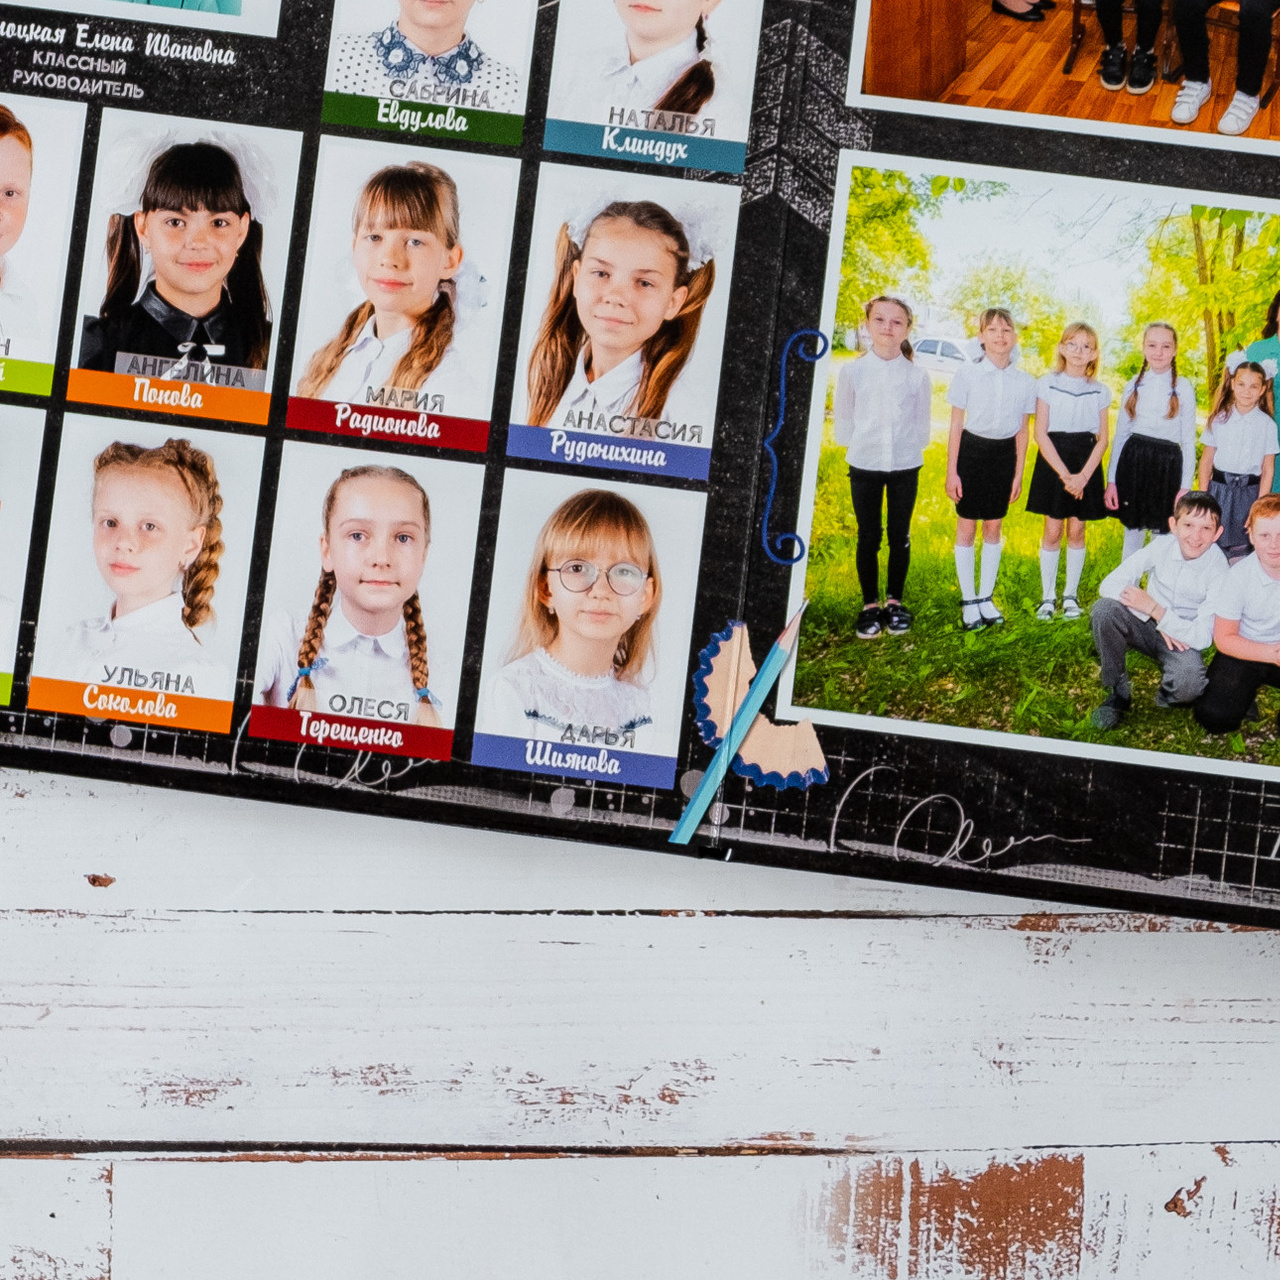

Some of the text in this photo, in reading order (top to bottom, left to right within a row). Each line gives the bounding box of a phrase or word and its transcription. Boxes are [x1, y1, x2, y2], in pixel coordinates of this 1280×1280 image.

[76, 23, 134, 52] Елена
[145, 32, 236, 65] Ивановна
[33, 49, 127, 75] КЛАССНЫЙ
[13, 70, 144, 99] РУКОВОДИТЕЛЬ
[388, 79, 490, 109] САБРИНА
[377, 99, 468, 133] Евдулова
[608, 106, 717, 136] НАТАЛЬЯ
[601, 127, 689, 164] Клиндух
[127, 357, 246, 388] АНГЕЛИНА
[133, 378, 204, 409] Попова
[366, 385, 446, 412] МАРИЯ
[334, 403, 441, 439] Радионова
[562, 410, 703, 444] АНАСТАСИЯ
[101, 665, 196, 695] УЛЬЯНА
[82, 685, 178, 718] Соколова
[328, 694, 410, 721] ОЛЕСЯ
[299, 711, 404, 748] Терещенко
[560, 723, 636, 749] ДАРЬЯ
[525, 741, 621, 774] Шиянова
